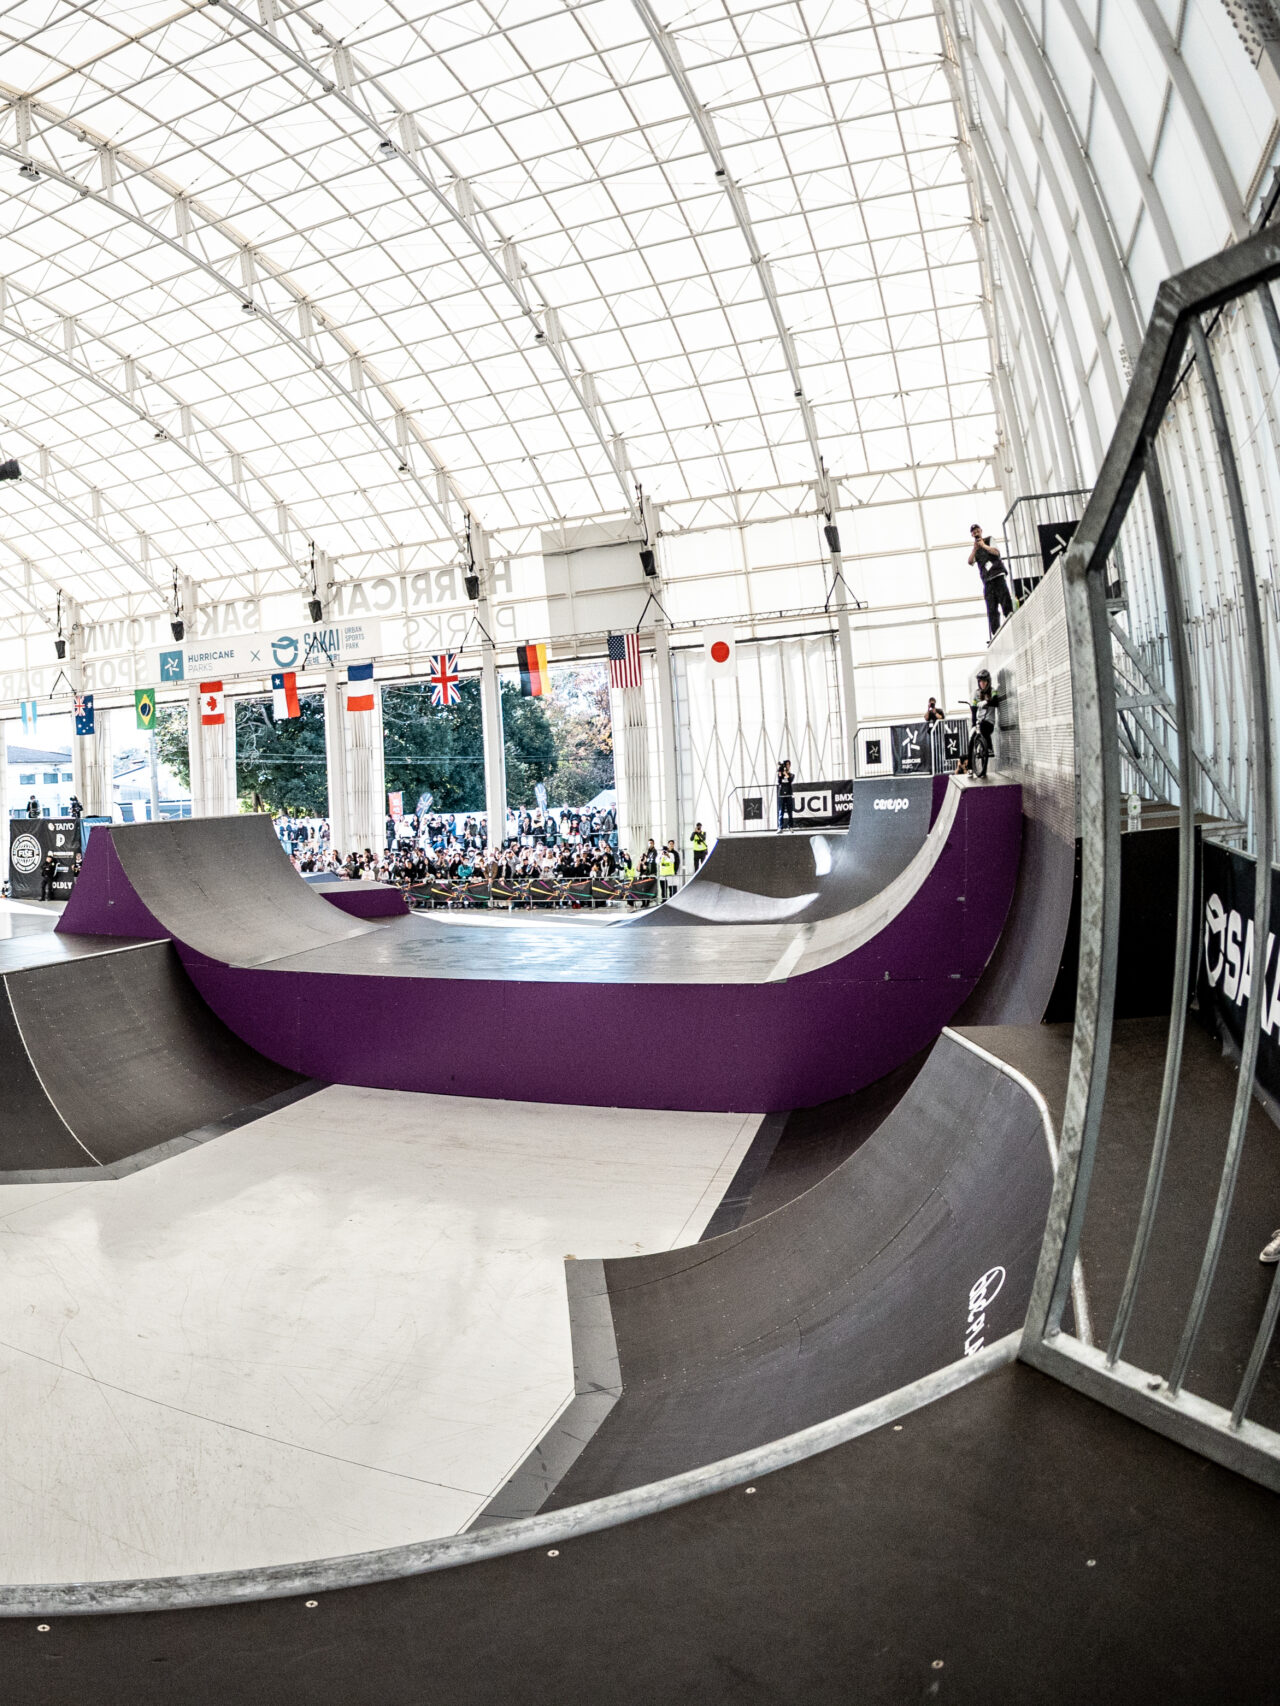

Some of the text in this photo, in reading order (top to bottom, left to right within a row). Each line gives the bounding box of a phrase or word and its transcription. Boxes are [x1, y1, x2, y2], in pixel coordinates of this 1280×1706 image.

[303, 629, 340, 654] SAKAI
[345, 634, 365, 642] SPORTS
[187, 650, 235, 663] HURRICANE
[188, 664, 214, 672] PARKS
[834, 793, 854, 802] BMX
[793, 795, 828, 813] UCI
